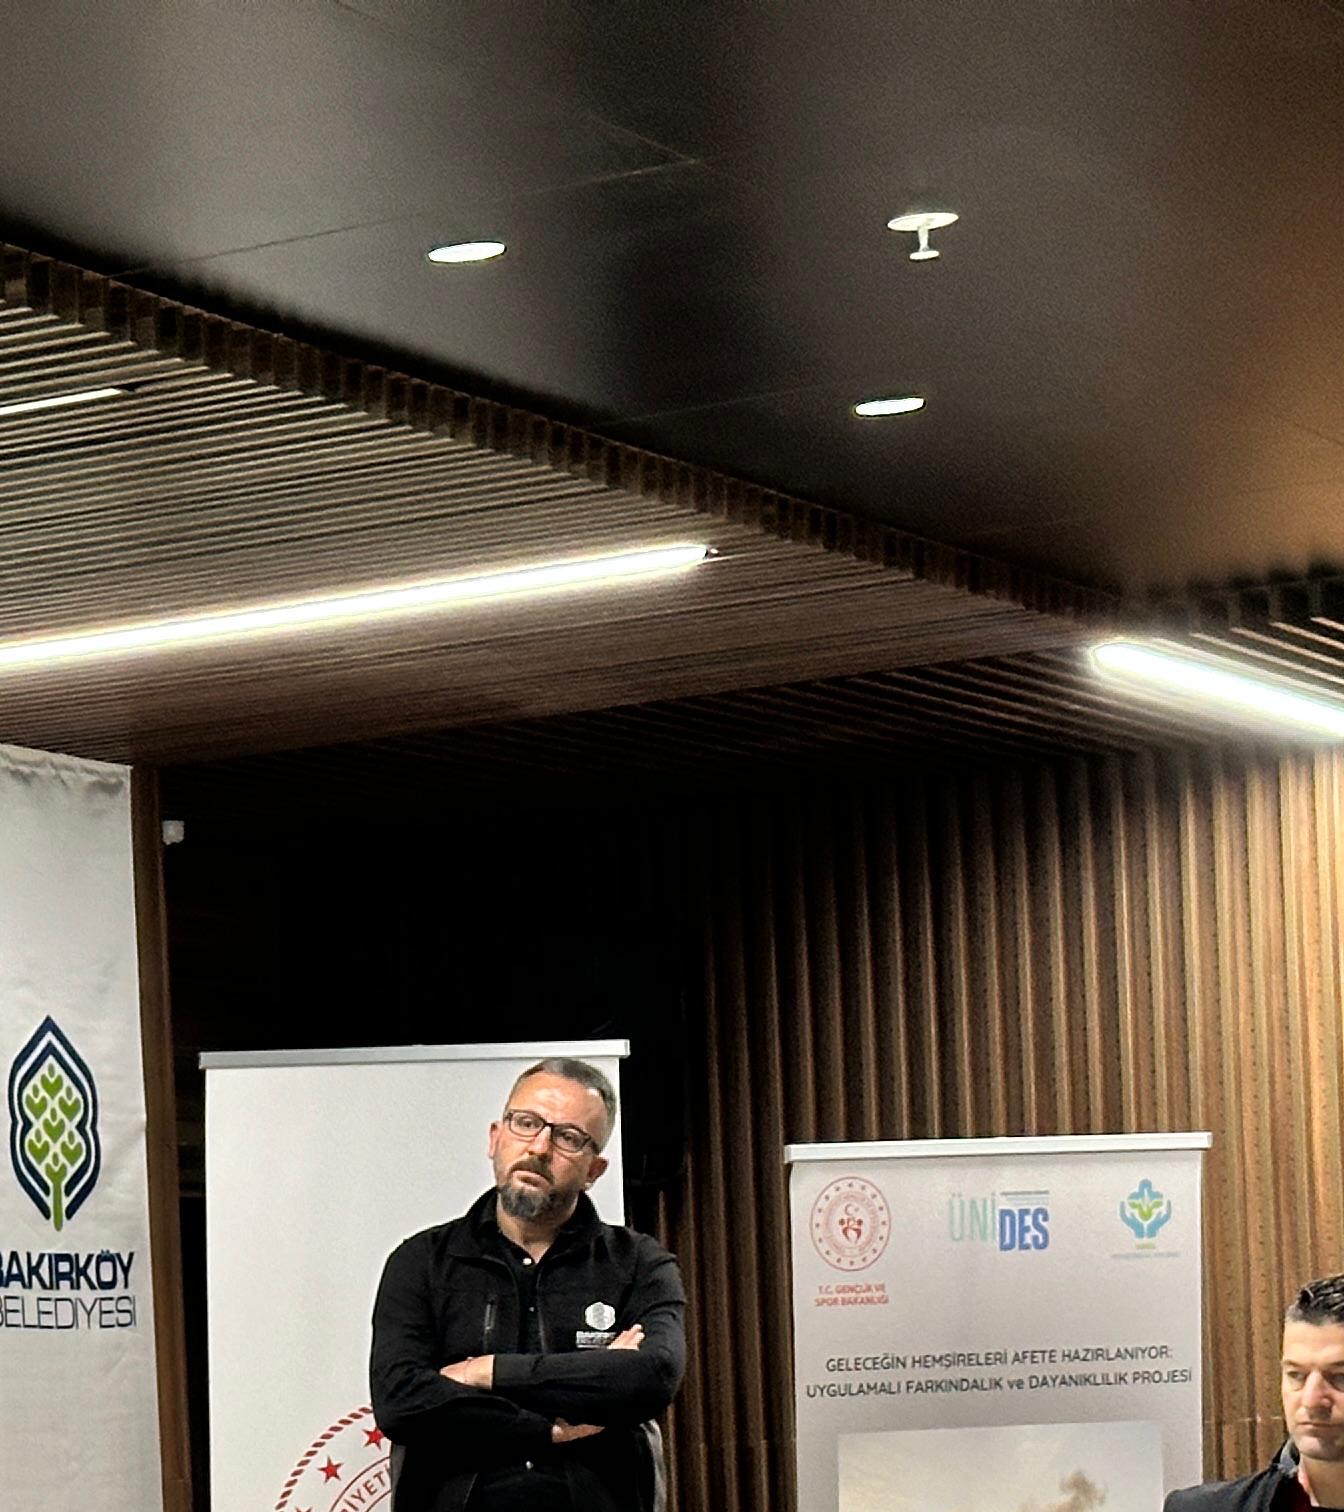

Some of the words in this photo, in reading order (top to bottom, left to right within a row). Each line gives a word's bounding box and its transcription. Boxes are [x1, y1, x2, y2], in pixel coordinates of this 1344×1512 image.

[826, 1352, 907, 1372] GELECEĞİN
[911, 1348, 1008, 1369] HEMŞİRELERİ
[1011, 1349, 1057, 1365] AFETE
[806, 1381, 901, 1398] UYGULAMALI
[905, 1377, 1004, 1394] FARKINDALIK
[1007, 1378, 1025, 1390] ve
[1028, 1372, 1129, 1390] DAYANIKLILIK
[1132, 1366, 1193, 1385] PROJESİ
